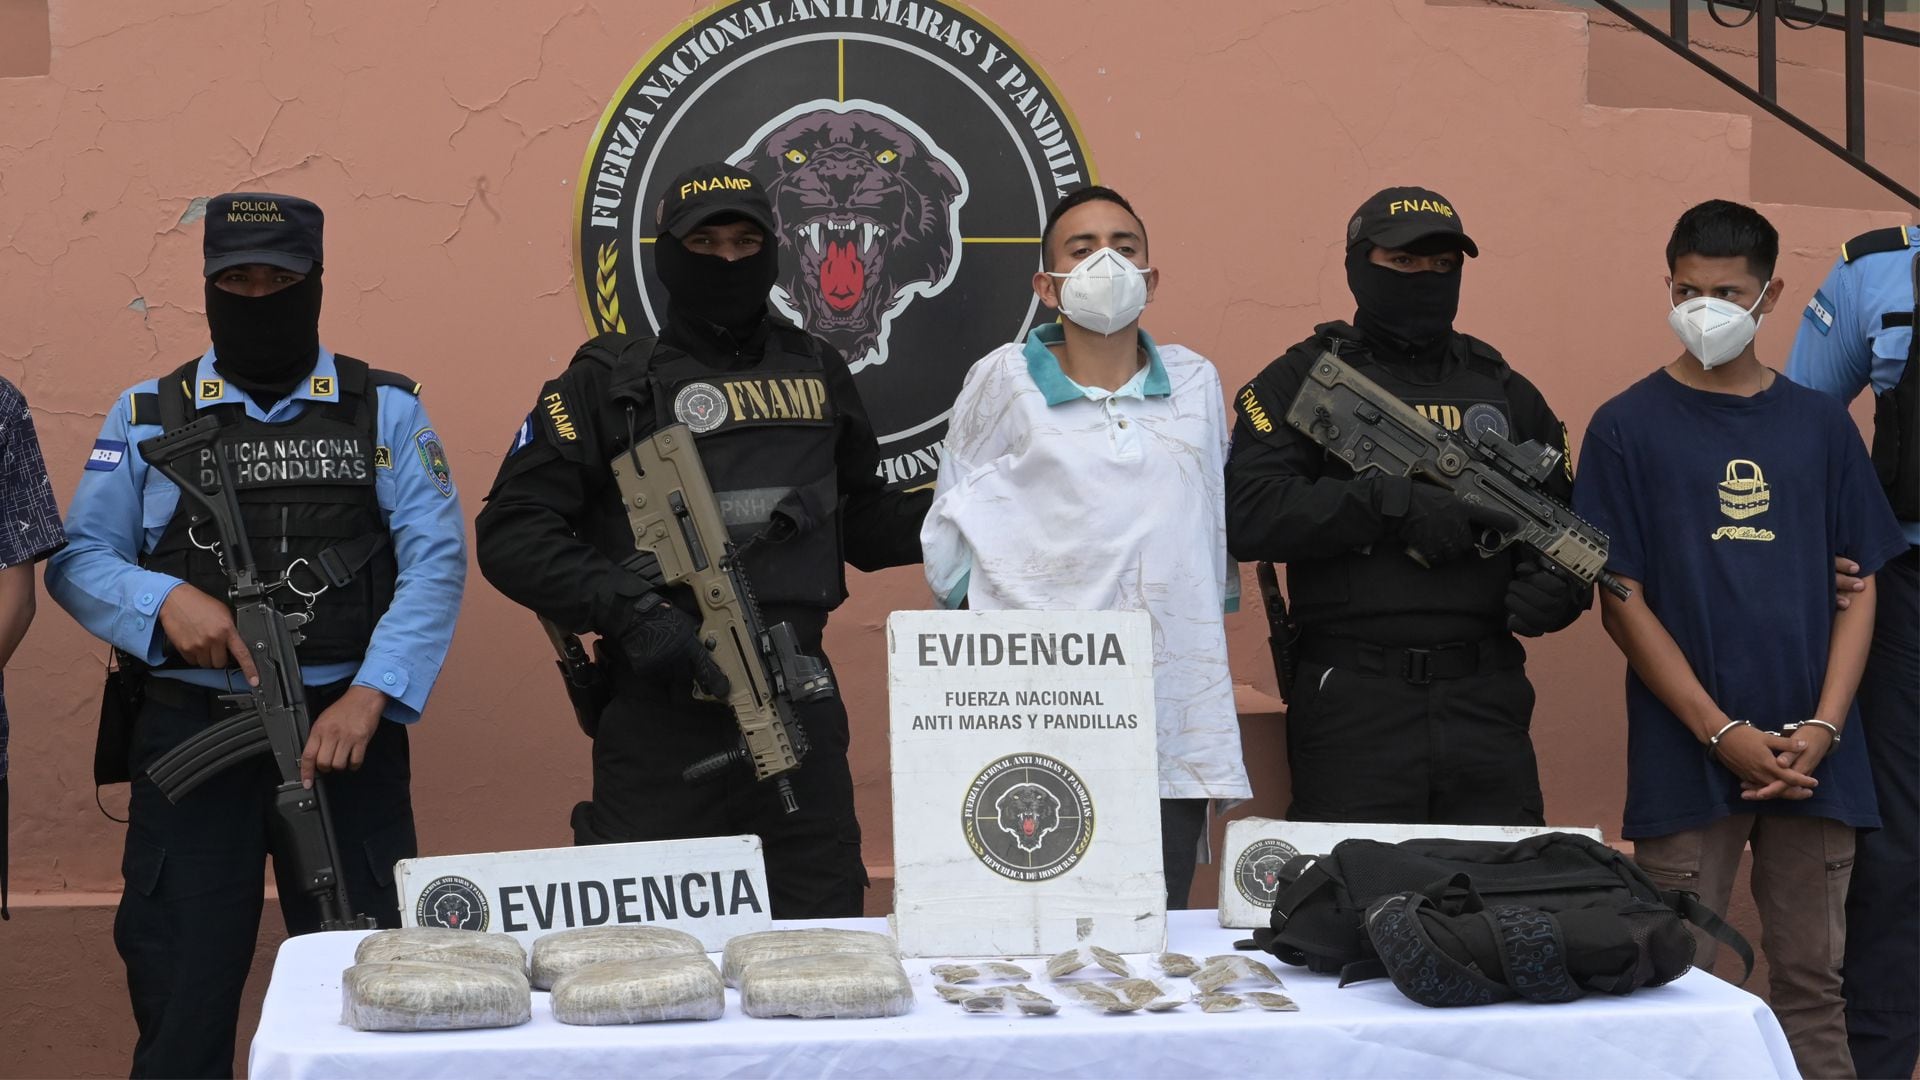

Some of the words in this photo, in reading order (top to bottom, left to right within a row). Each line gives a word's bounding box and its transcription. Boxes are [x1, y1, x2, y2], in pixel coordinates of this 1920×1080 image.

[591, 107, 654, 229] FUERZA
[638, 1, 784, 110] NACIONAL
[871, 0, 982, 56] MARAS
[978, 43, 1007, 73] Y
[996, 64, 1081, 199] PANDILL
[681, 176, 752, 200] FNAMP
[227, 213, 285, 222] NACIONAL
[232, 201, 278, 211] POLICIA
[1390, 199, 1453, 218] FNAMP
[723, 378, 826, 421] FNAMP
[1240, 388, 1272, 432] FNAMP
[544, 392, 577, 440] FNAMP
[274, 439, 365, 460] NACIONAL
[875, 439, 946, 484] HON
[237, 460, 367, 484] HONDURAS
[918, 633, 1126, 666] EVIDENCIA
[945, 691, 1010, 707] FUERZA
[1015, 690, 1104, 706] NACIONAL
[912, 715, 953, 730] ANTI
[959, 714, 1022, 730] MARAS
[1025, 714, 1038, 729] Y
[1044, 713, 1138, 730] PANDILLAS
[965, 790, 980, 817] FUERZA
[976, 760, 1012, 787] NACIONAL
[1014, 756, 1033, 765] ANTI
[1035, 757, 1062, 773] MARAS
[1061, 770, 1070, 778] Y
[1067, 776, 1092, 817] PANDILLAS
[983, 854, 1024, 880] REPUBLICA
[1038, 854, 1078, 879] HONDURAS
[499, 869, 763, 933] EVIDENCIA
